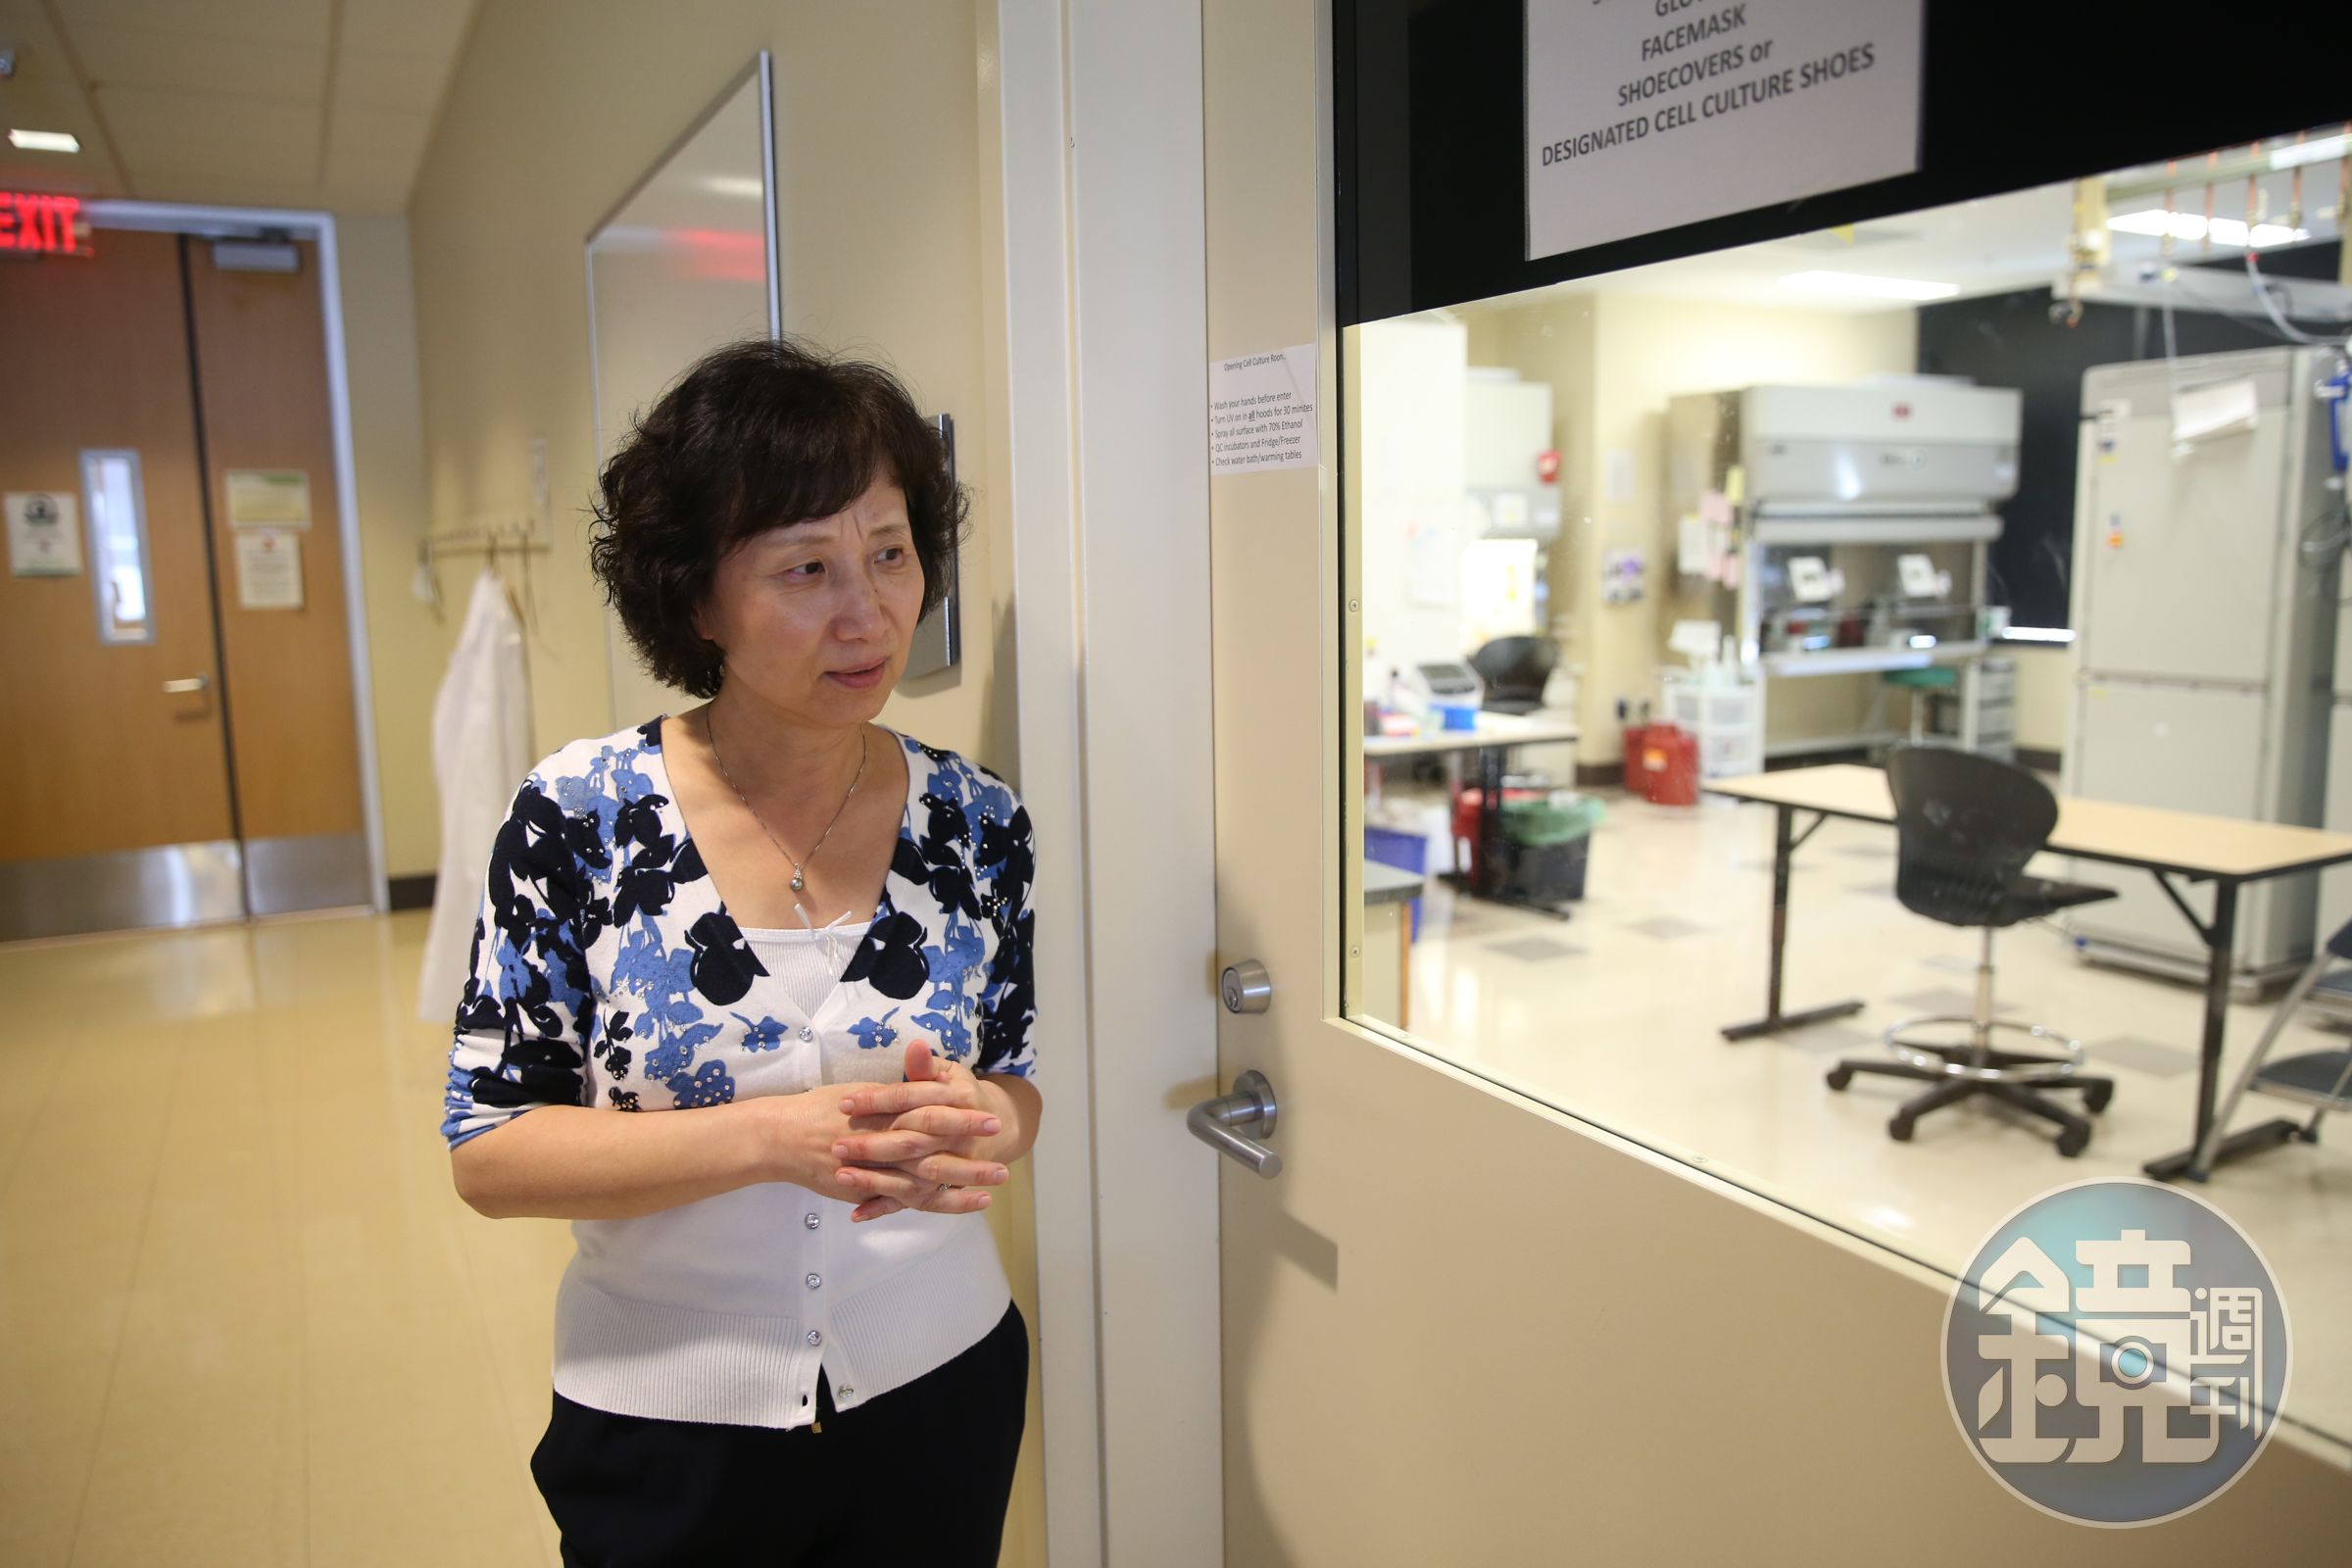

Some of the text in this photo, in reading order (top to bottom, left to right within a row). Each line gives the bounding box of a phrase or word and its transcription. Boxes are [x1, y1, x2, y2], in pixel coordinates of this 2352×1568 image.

[1642, 4, 1746, 61] FACEMASK
[1618, 40, 1774, 107] SHOECOVERS or
[1542, 42, 1875, 167] DESIGNATED CELL CULTURE SHOES
[0, 192, 78, 253] EXIT
[1224, 362, 1243, 371] Opening
[1252, 357, 1270, 366] Culture
[1214, 392, 1292, 410] Wash your hands before enter
[1215, 415, 1226, 423] Turn
[1227, 414, 1234, 422] UV
[1256, 408, 1273, 418] hoods
[1284, 405, 1291, 415] 30
[1292, 404, 1313, 414] minutes
[1215, 429, 1228, 439] Spray
[1236, 426, 1254, 435] surface
[1255, 423, 1267, 433] with
[1269, 421, 1281, 431] 70%
[1282, 418, 1302, 430] Ethanol
[1224, 441, 1249, 451] incubators
[1250, 439, 1260, 448] and
[1261, 435, 1300, 448] Fridge/Freezer
[1215, 458, 1230, 466] Check
[1231, 456, 1246, 465] water
[1285, 450, 1301, 460] tables
